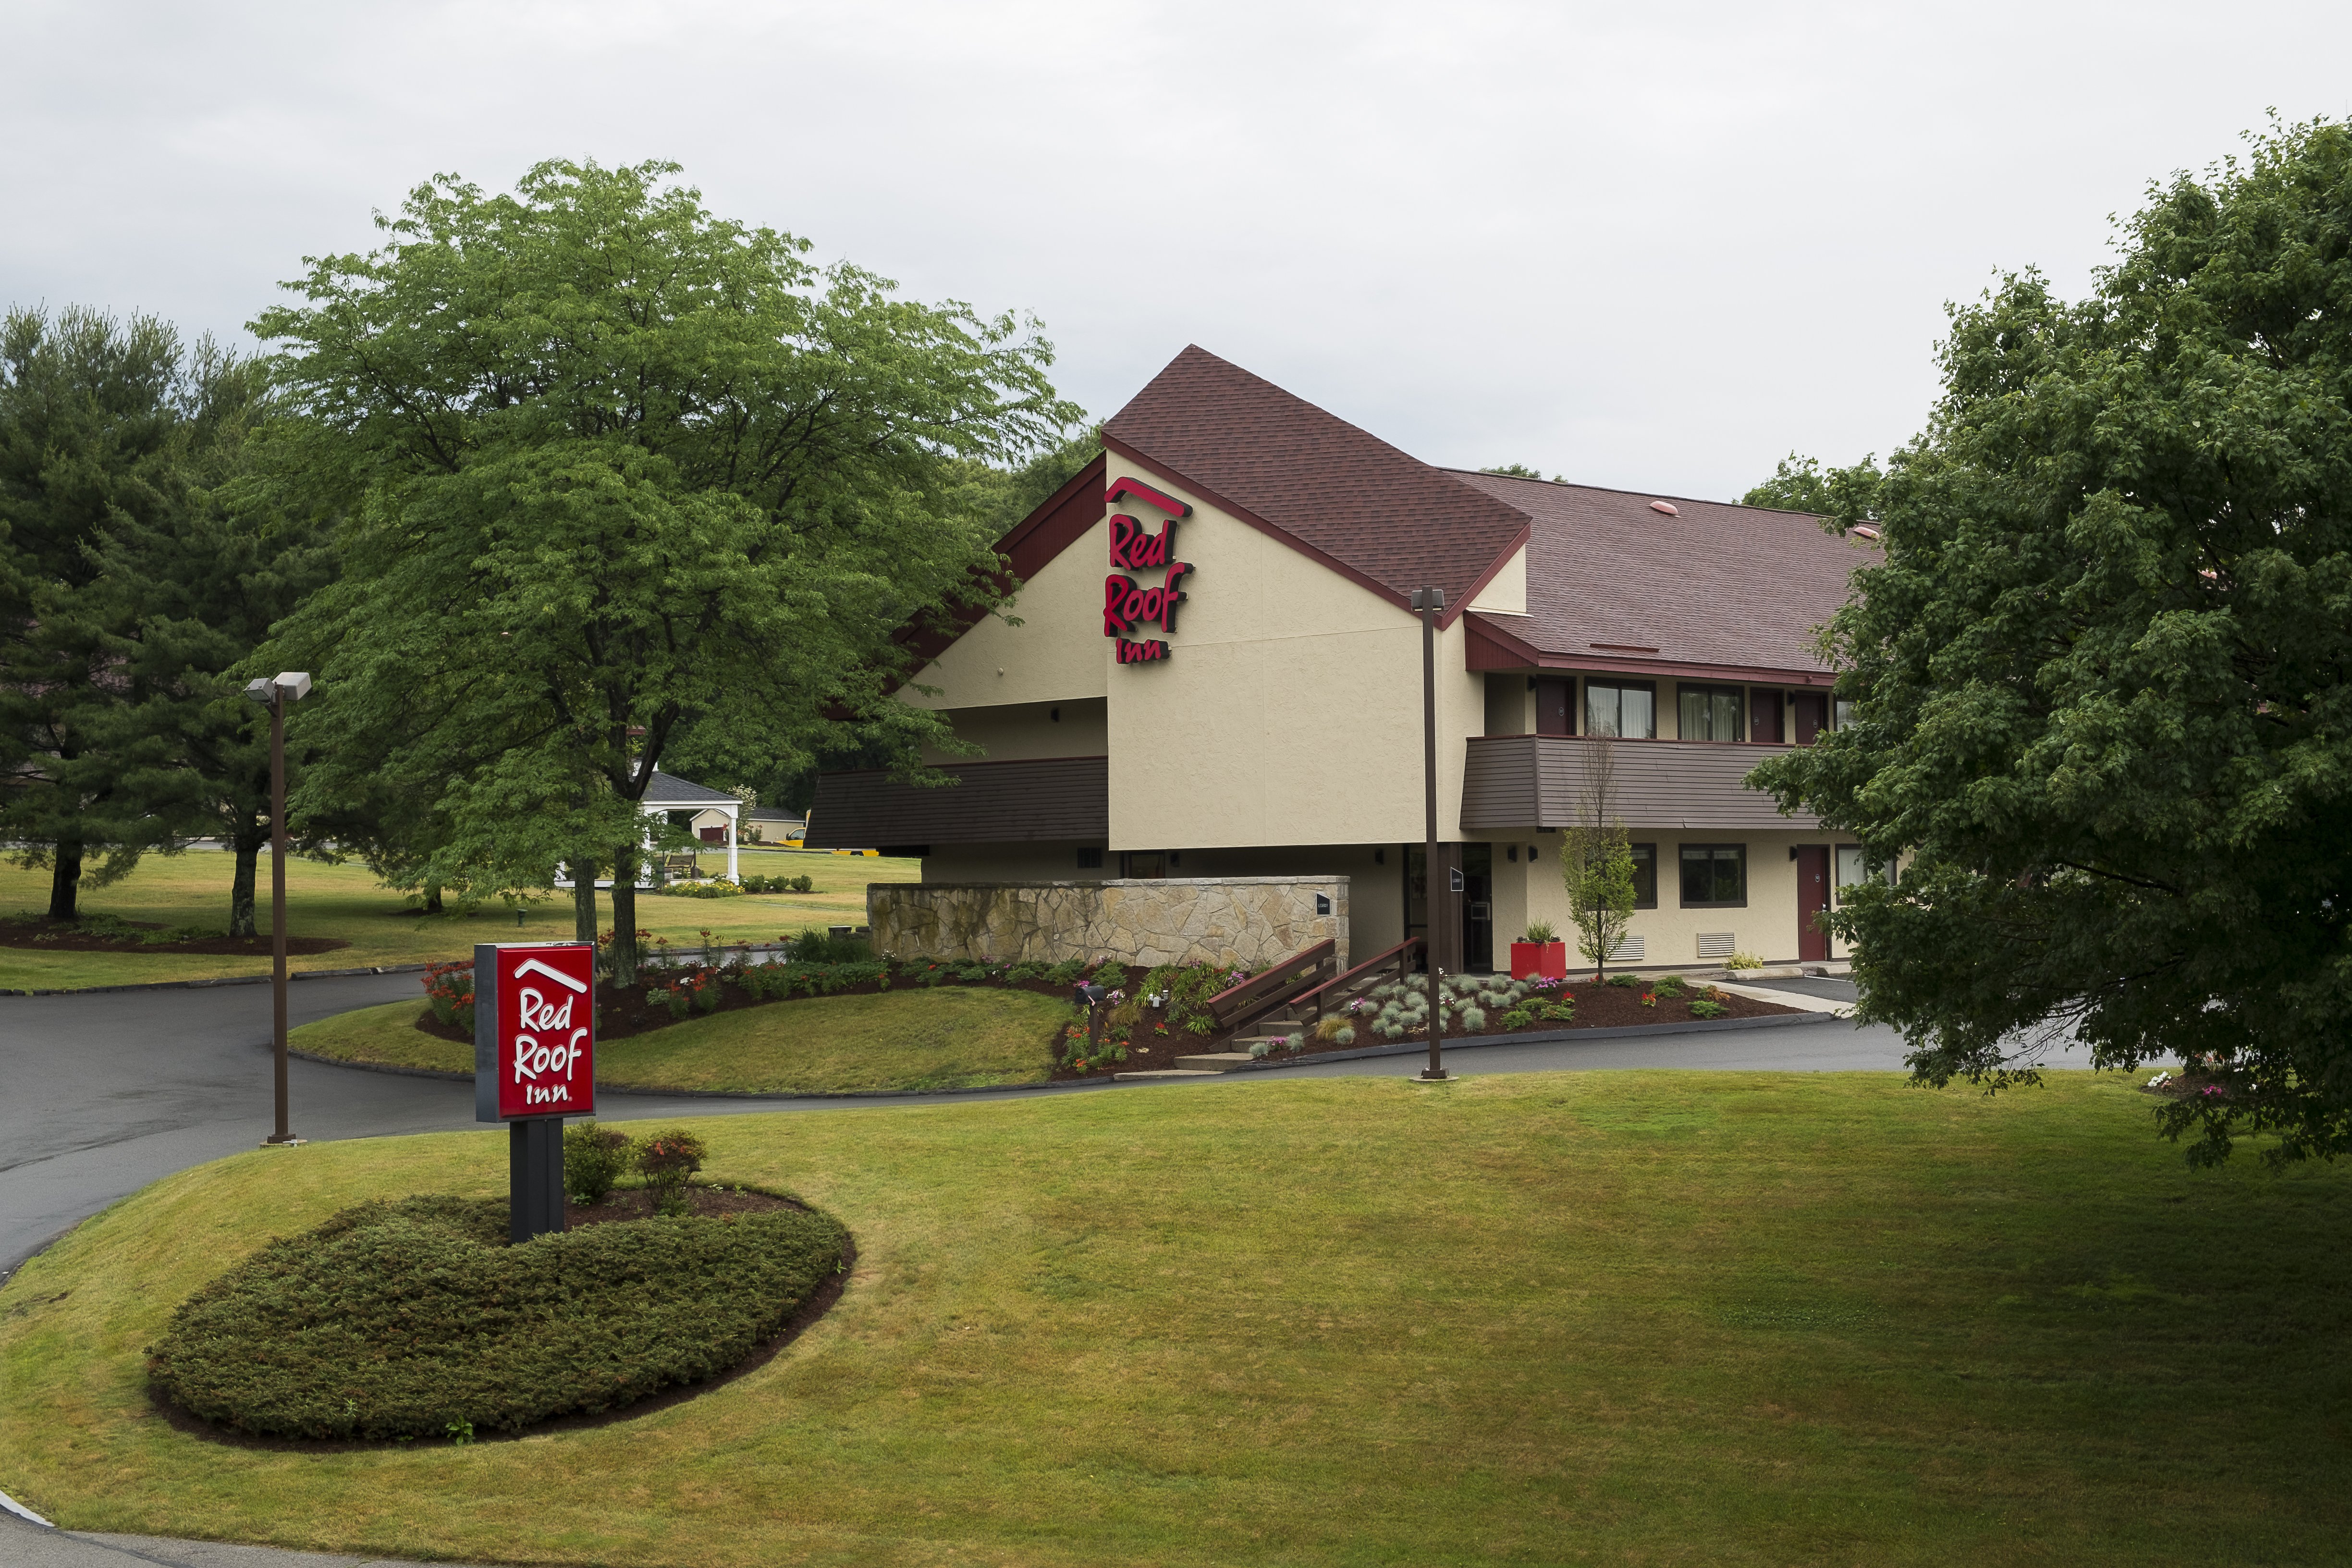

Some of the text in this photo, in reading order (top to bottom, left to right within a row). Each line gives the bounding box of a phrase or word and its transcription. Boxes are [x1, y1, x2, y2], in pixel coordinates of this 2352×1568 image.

[1109, 514, 1177, 571] Red
[1103, 562, 1195, 637] Roof
[1116, 638, 1170, 664] Inn
[519, 987, 573, 1032] Red
[513, 1027, 588, 1084] Roof
[526, 1084, 568, 1104] Inn
